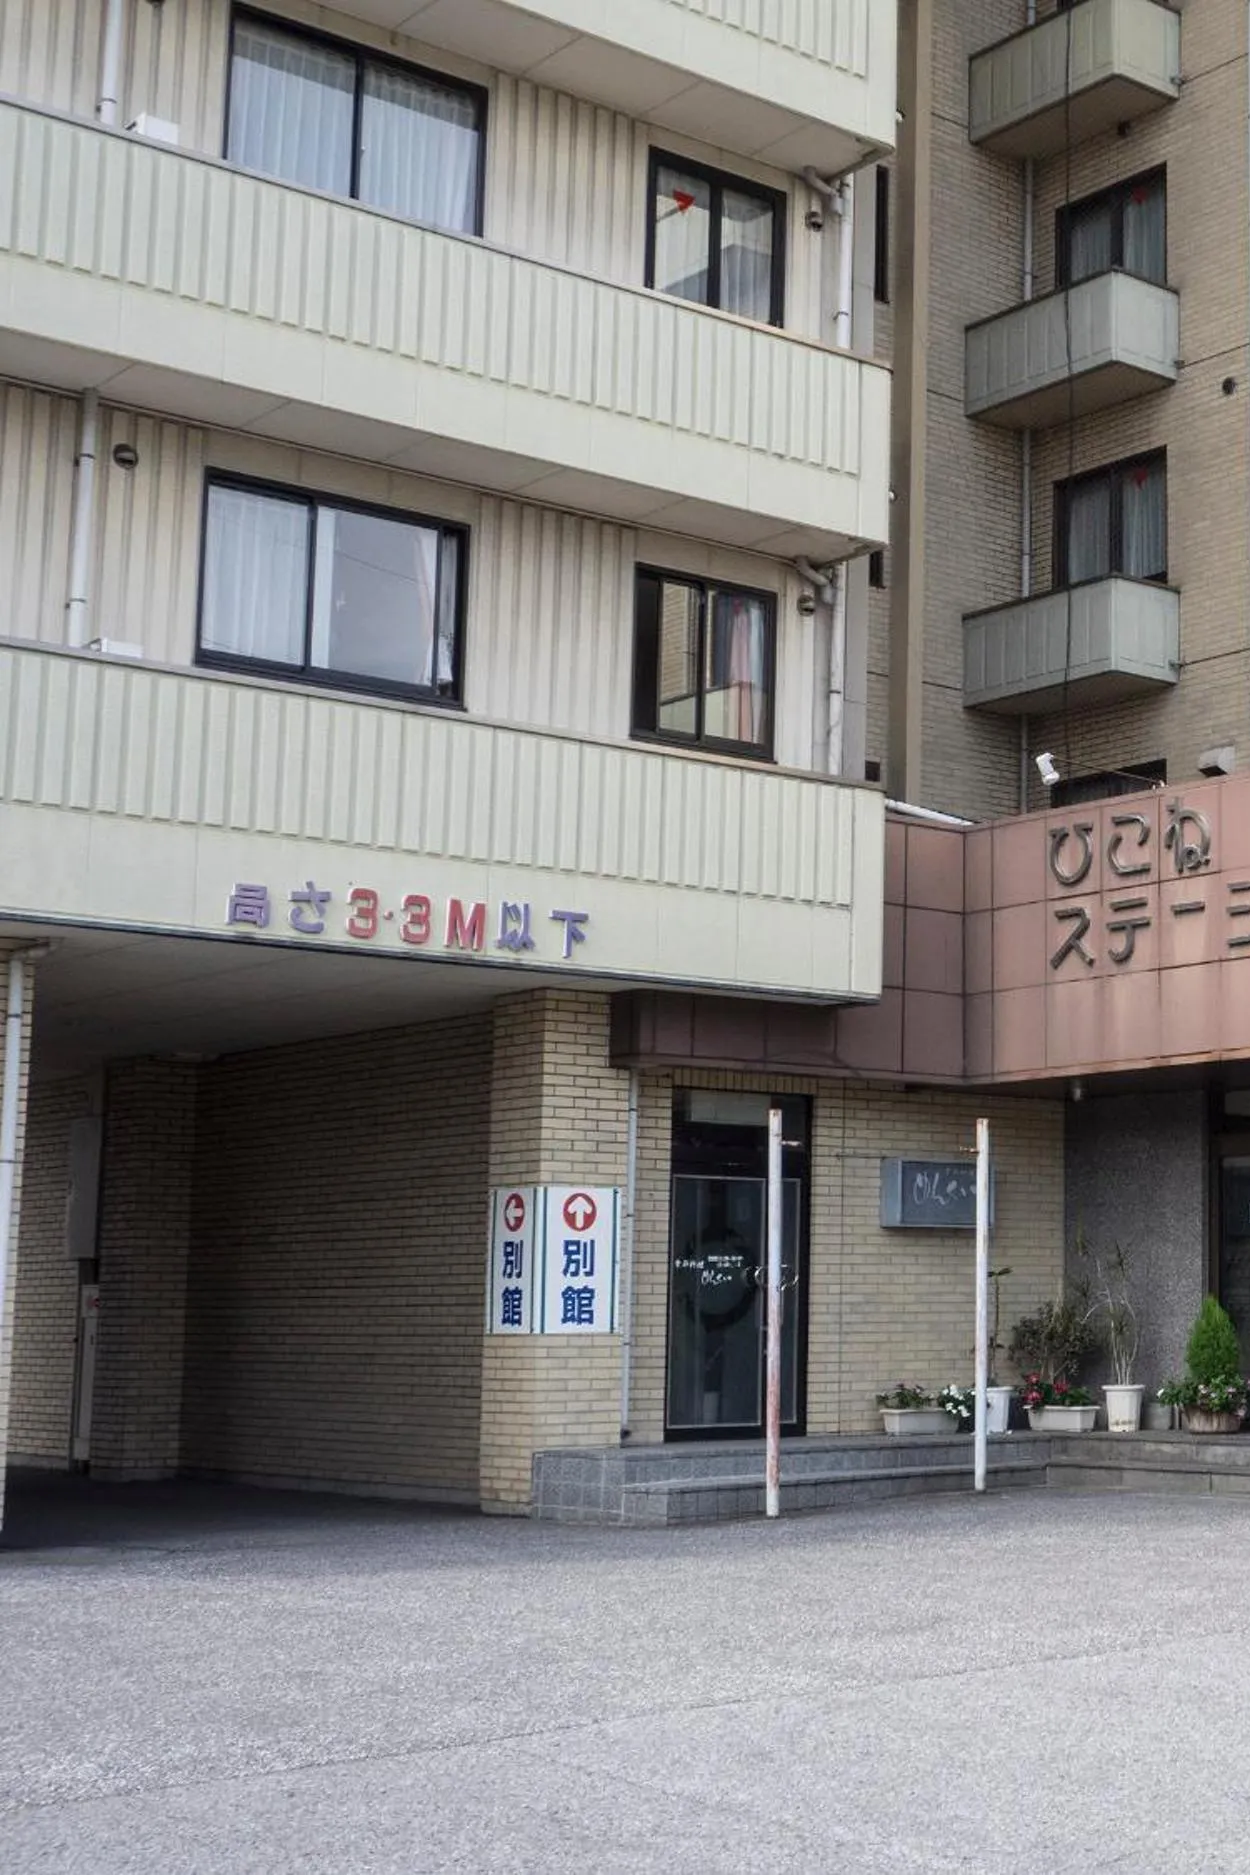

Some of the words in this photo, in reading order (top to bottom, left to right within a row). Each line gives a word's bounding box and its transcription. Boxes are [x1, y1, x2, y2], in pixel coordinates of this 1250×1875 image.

[1048, 797, 1211, 888] ひこね
[501, 1239, 523, 1328] 別館
[561, 1239, 596, 1326] 別館
